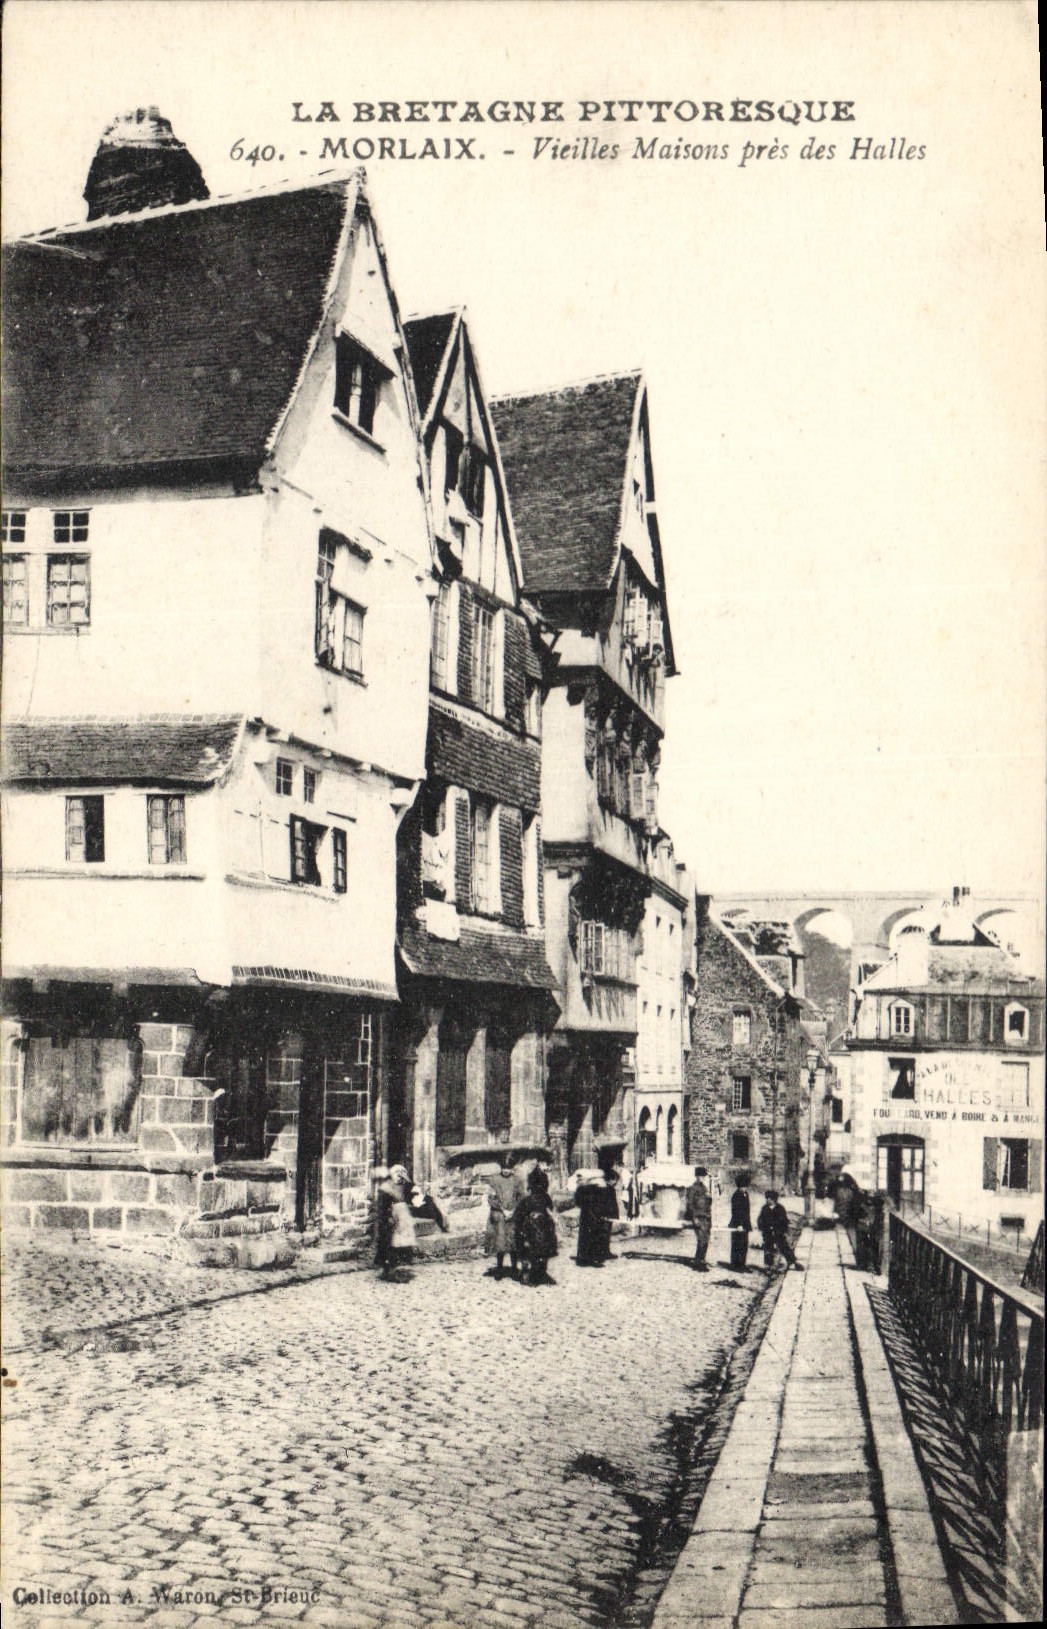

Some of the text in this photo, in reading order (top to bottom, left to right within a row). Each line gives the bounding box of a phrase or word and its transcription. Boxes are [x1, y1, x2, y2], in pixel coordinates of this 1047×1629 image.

[923, 1089, 992, 1105] HALLES
[924, 1110, 948, 1121] VEND
[961, 1111, 985, 1121] BOIRE
